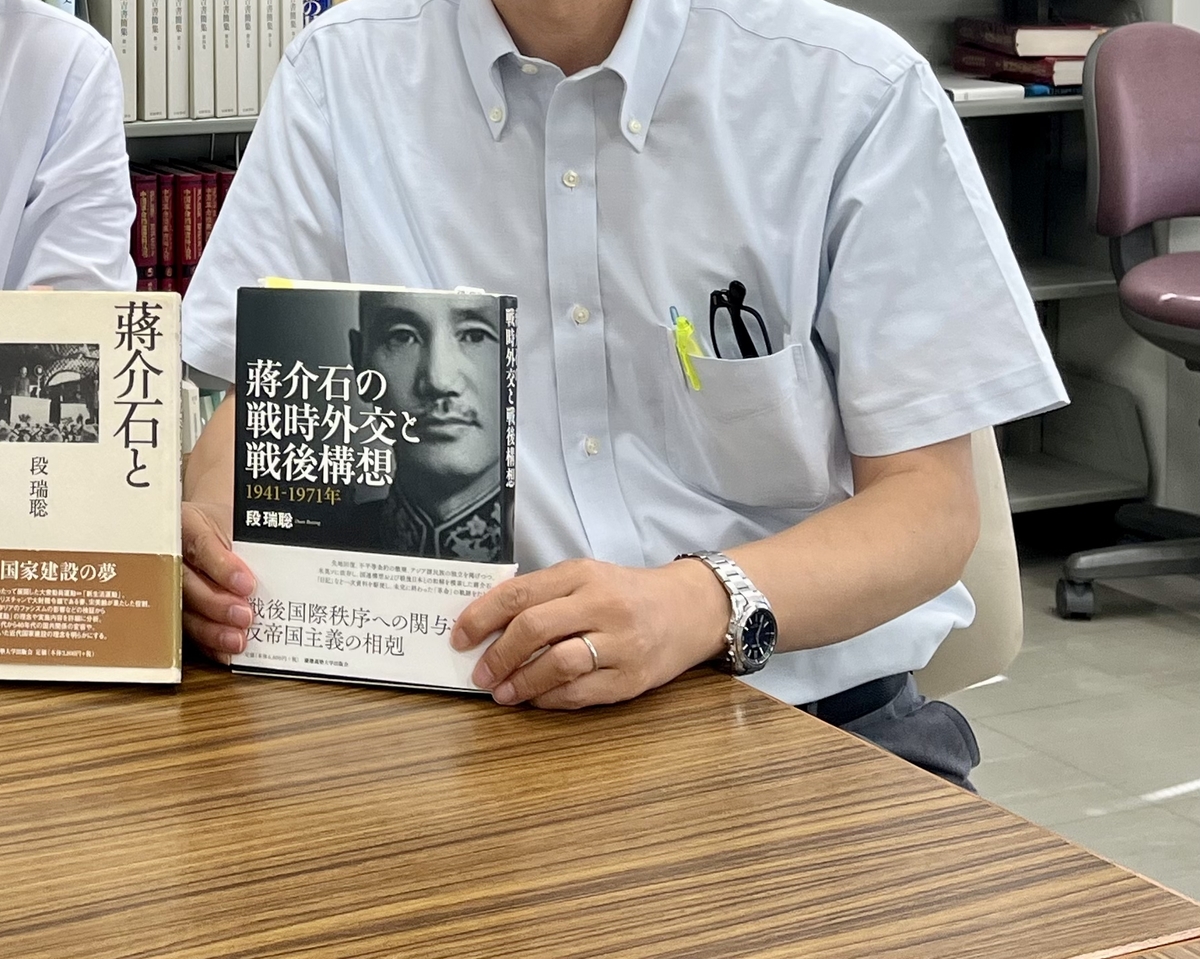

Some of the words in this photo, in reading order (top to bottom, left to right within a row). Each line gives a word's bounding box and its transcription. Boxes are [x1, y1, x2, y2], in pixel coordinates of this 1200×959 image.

[245, 401, 421, 446] 戦時外交と
[245, 441, 394, 487] 戦後構想
[245, 484, 341, 506] 1941-1971年
[245, 625, 405, 657] 反帝国主義の相剋
